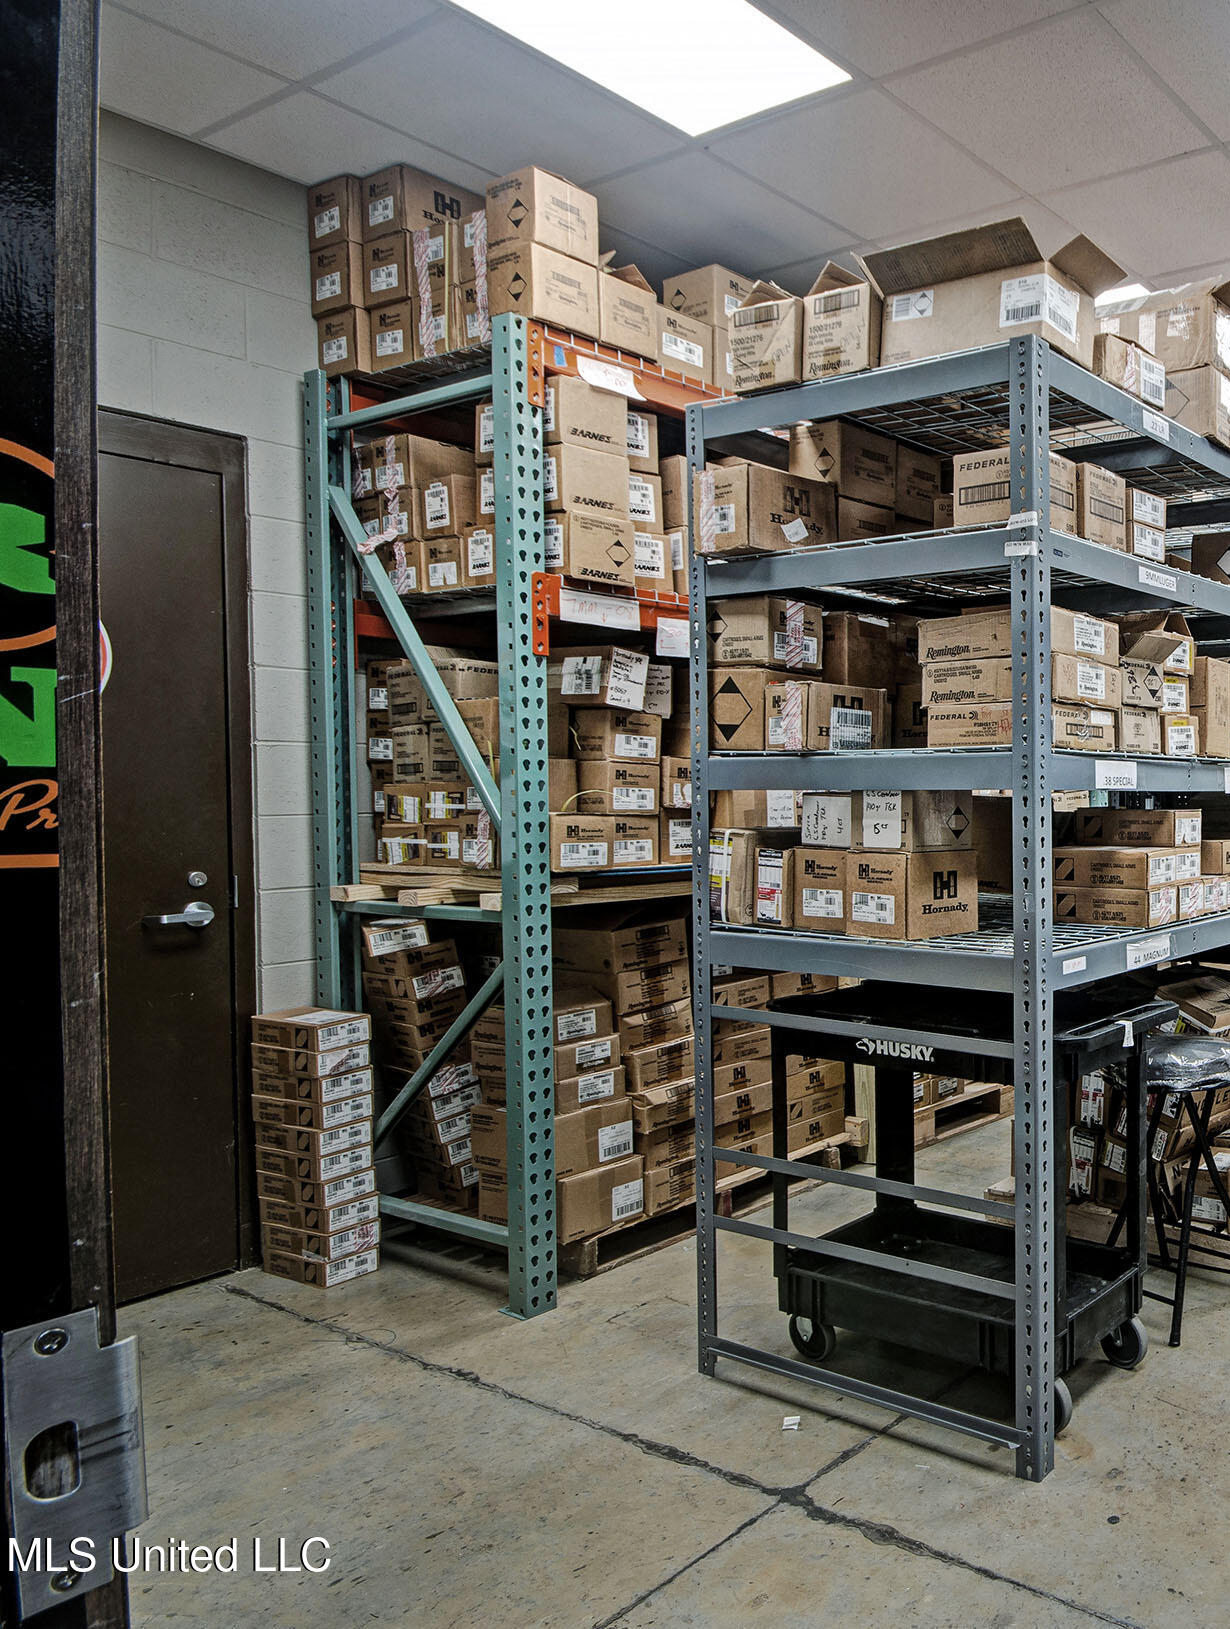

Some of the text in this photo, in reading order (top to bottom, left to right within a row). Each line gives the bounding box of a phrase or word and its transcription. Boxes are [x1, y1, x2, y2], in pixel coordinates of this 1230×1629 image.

[959, 458, 1010, 472] FEDERAL
[578, 567, 621, 582] BARNES
[926, 644, 970, 659] Remington
[467, 666, 499, 675] FEDER
[929, 690, 976, 703] Remington
[1113, 776, 1134, 786] SPECIAL
[922, 902, 968, 915] Hornady
[1143, 947, 1169, 961] MAGNUM
[875, 1038, 933, 1061] HUSKY
